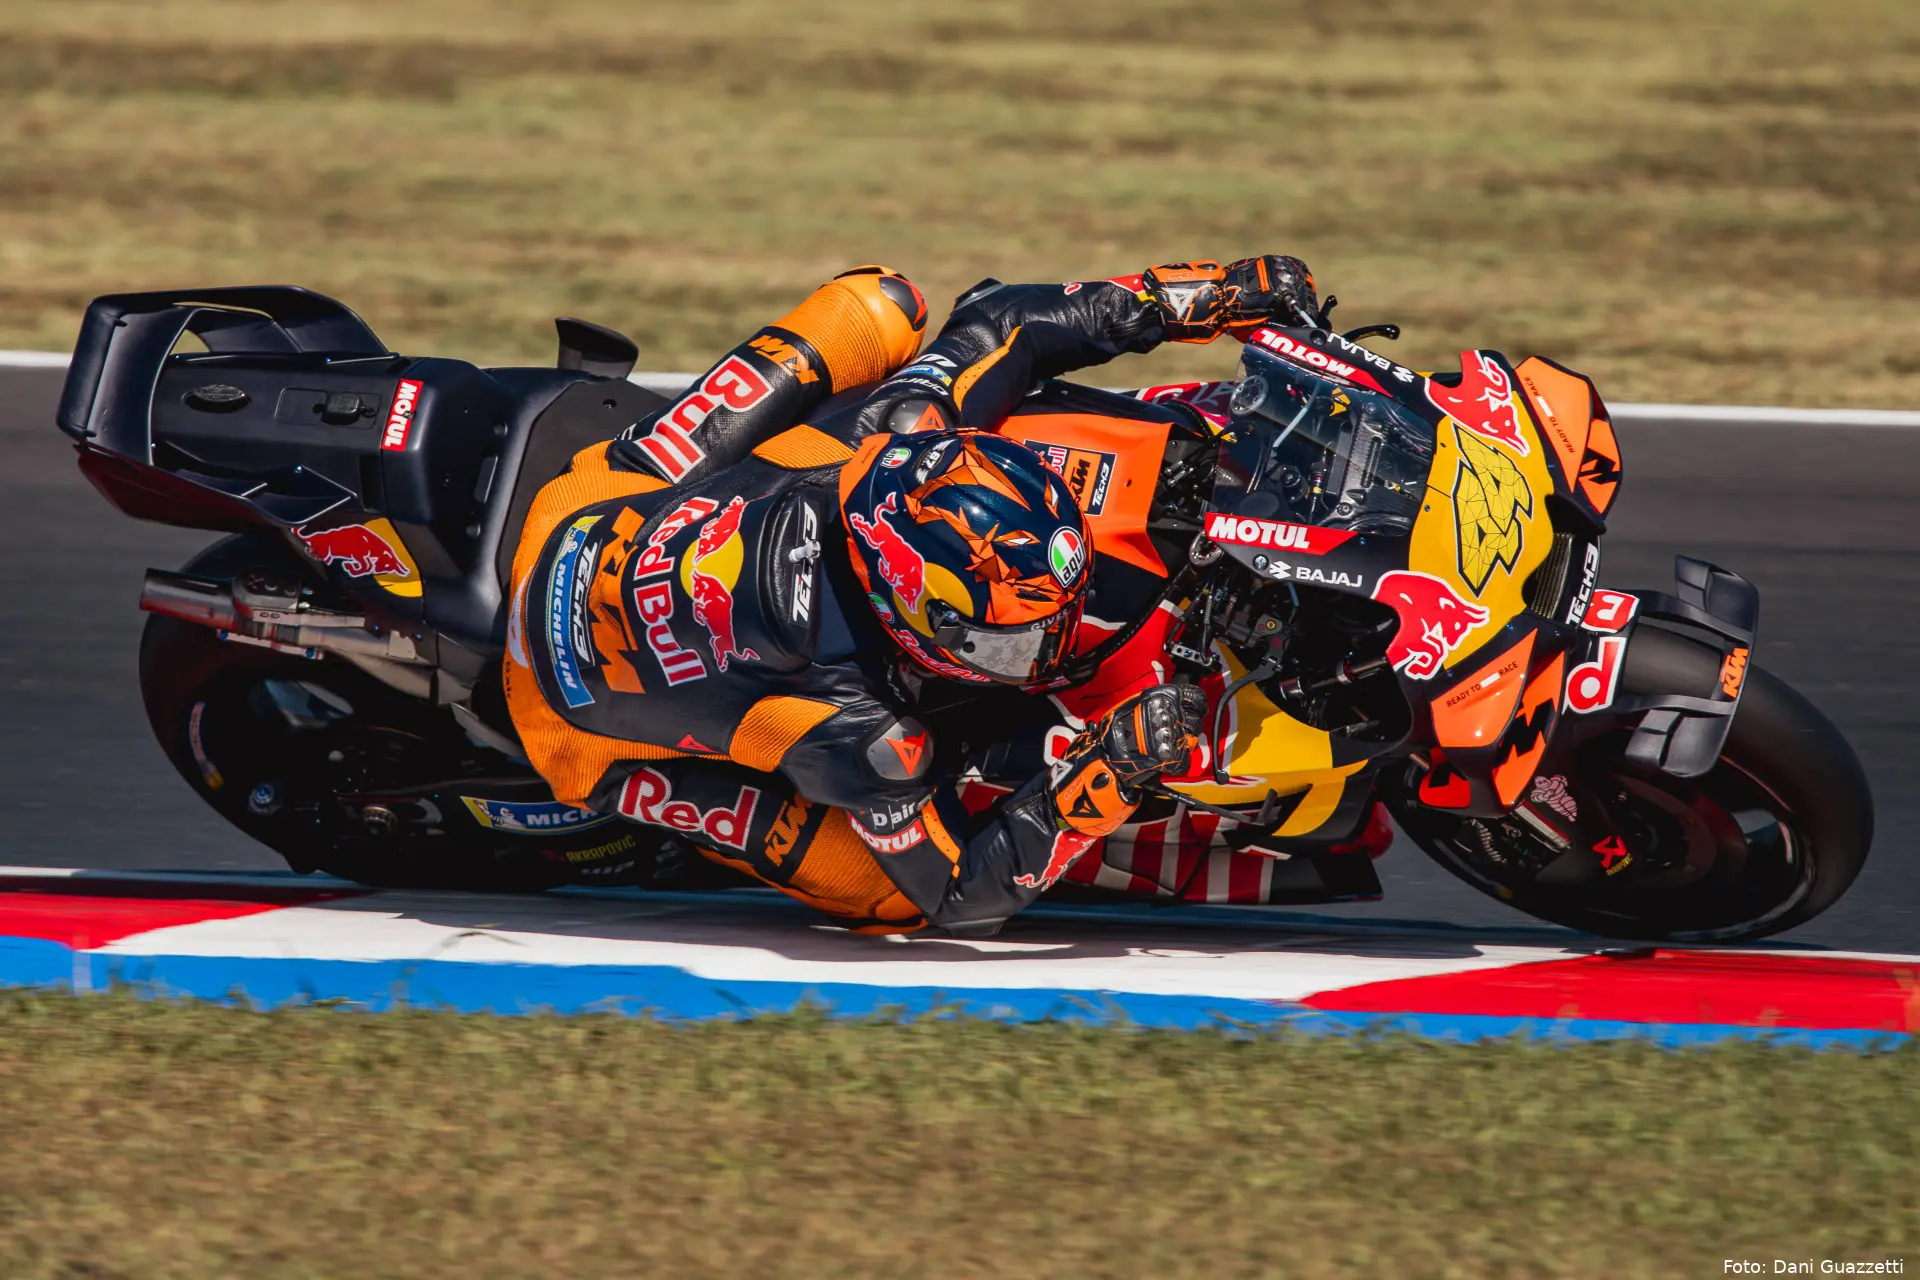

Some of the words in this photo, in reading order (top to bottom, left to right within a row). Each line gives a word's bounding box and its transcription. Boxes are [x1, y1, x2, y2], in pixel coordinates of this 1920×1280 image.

[747, 335, 820, 384] KTM
[1260, 329, 1356, 376] MOTUL
[1327, 332, 1391, 371] BAJAJ
[1524, 376, 1540, 396] RACE
[384, 382, 418, 447] MOTUL
[633, 354, 775, 484] Bull
[1549, 416, 1558, 427] TO
[1556, 428, 1575, 453] READY
[1092, 462, 1109, 506] TECH3
[634, 496, 720, 581] Red
[1209, 516, 1310, 549] MOTUL
[573, 542, 598, 662] TECH3
[590, 506, 646, 694] KTM
[1296, 567, 1363, 588] BAJAJ
[1565, 542, 1598, 625] TECH3
[553, 563, 579, 689] MICHELIN
[633, 579, 708, 687] Bull
[1446, 689, 1470, 708] READY
[1470, 683, 1481, 693] TO
[1498, 661, 1519, 677] RACE
[1720, 647, 1749, 699] KTM
[526, 809, 598, 827] MICH
[617, 766, 761, 851] Red
[765, 800, 808, 867] KTM
[851, 818, 922, 851] MOTUL
